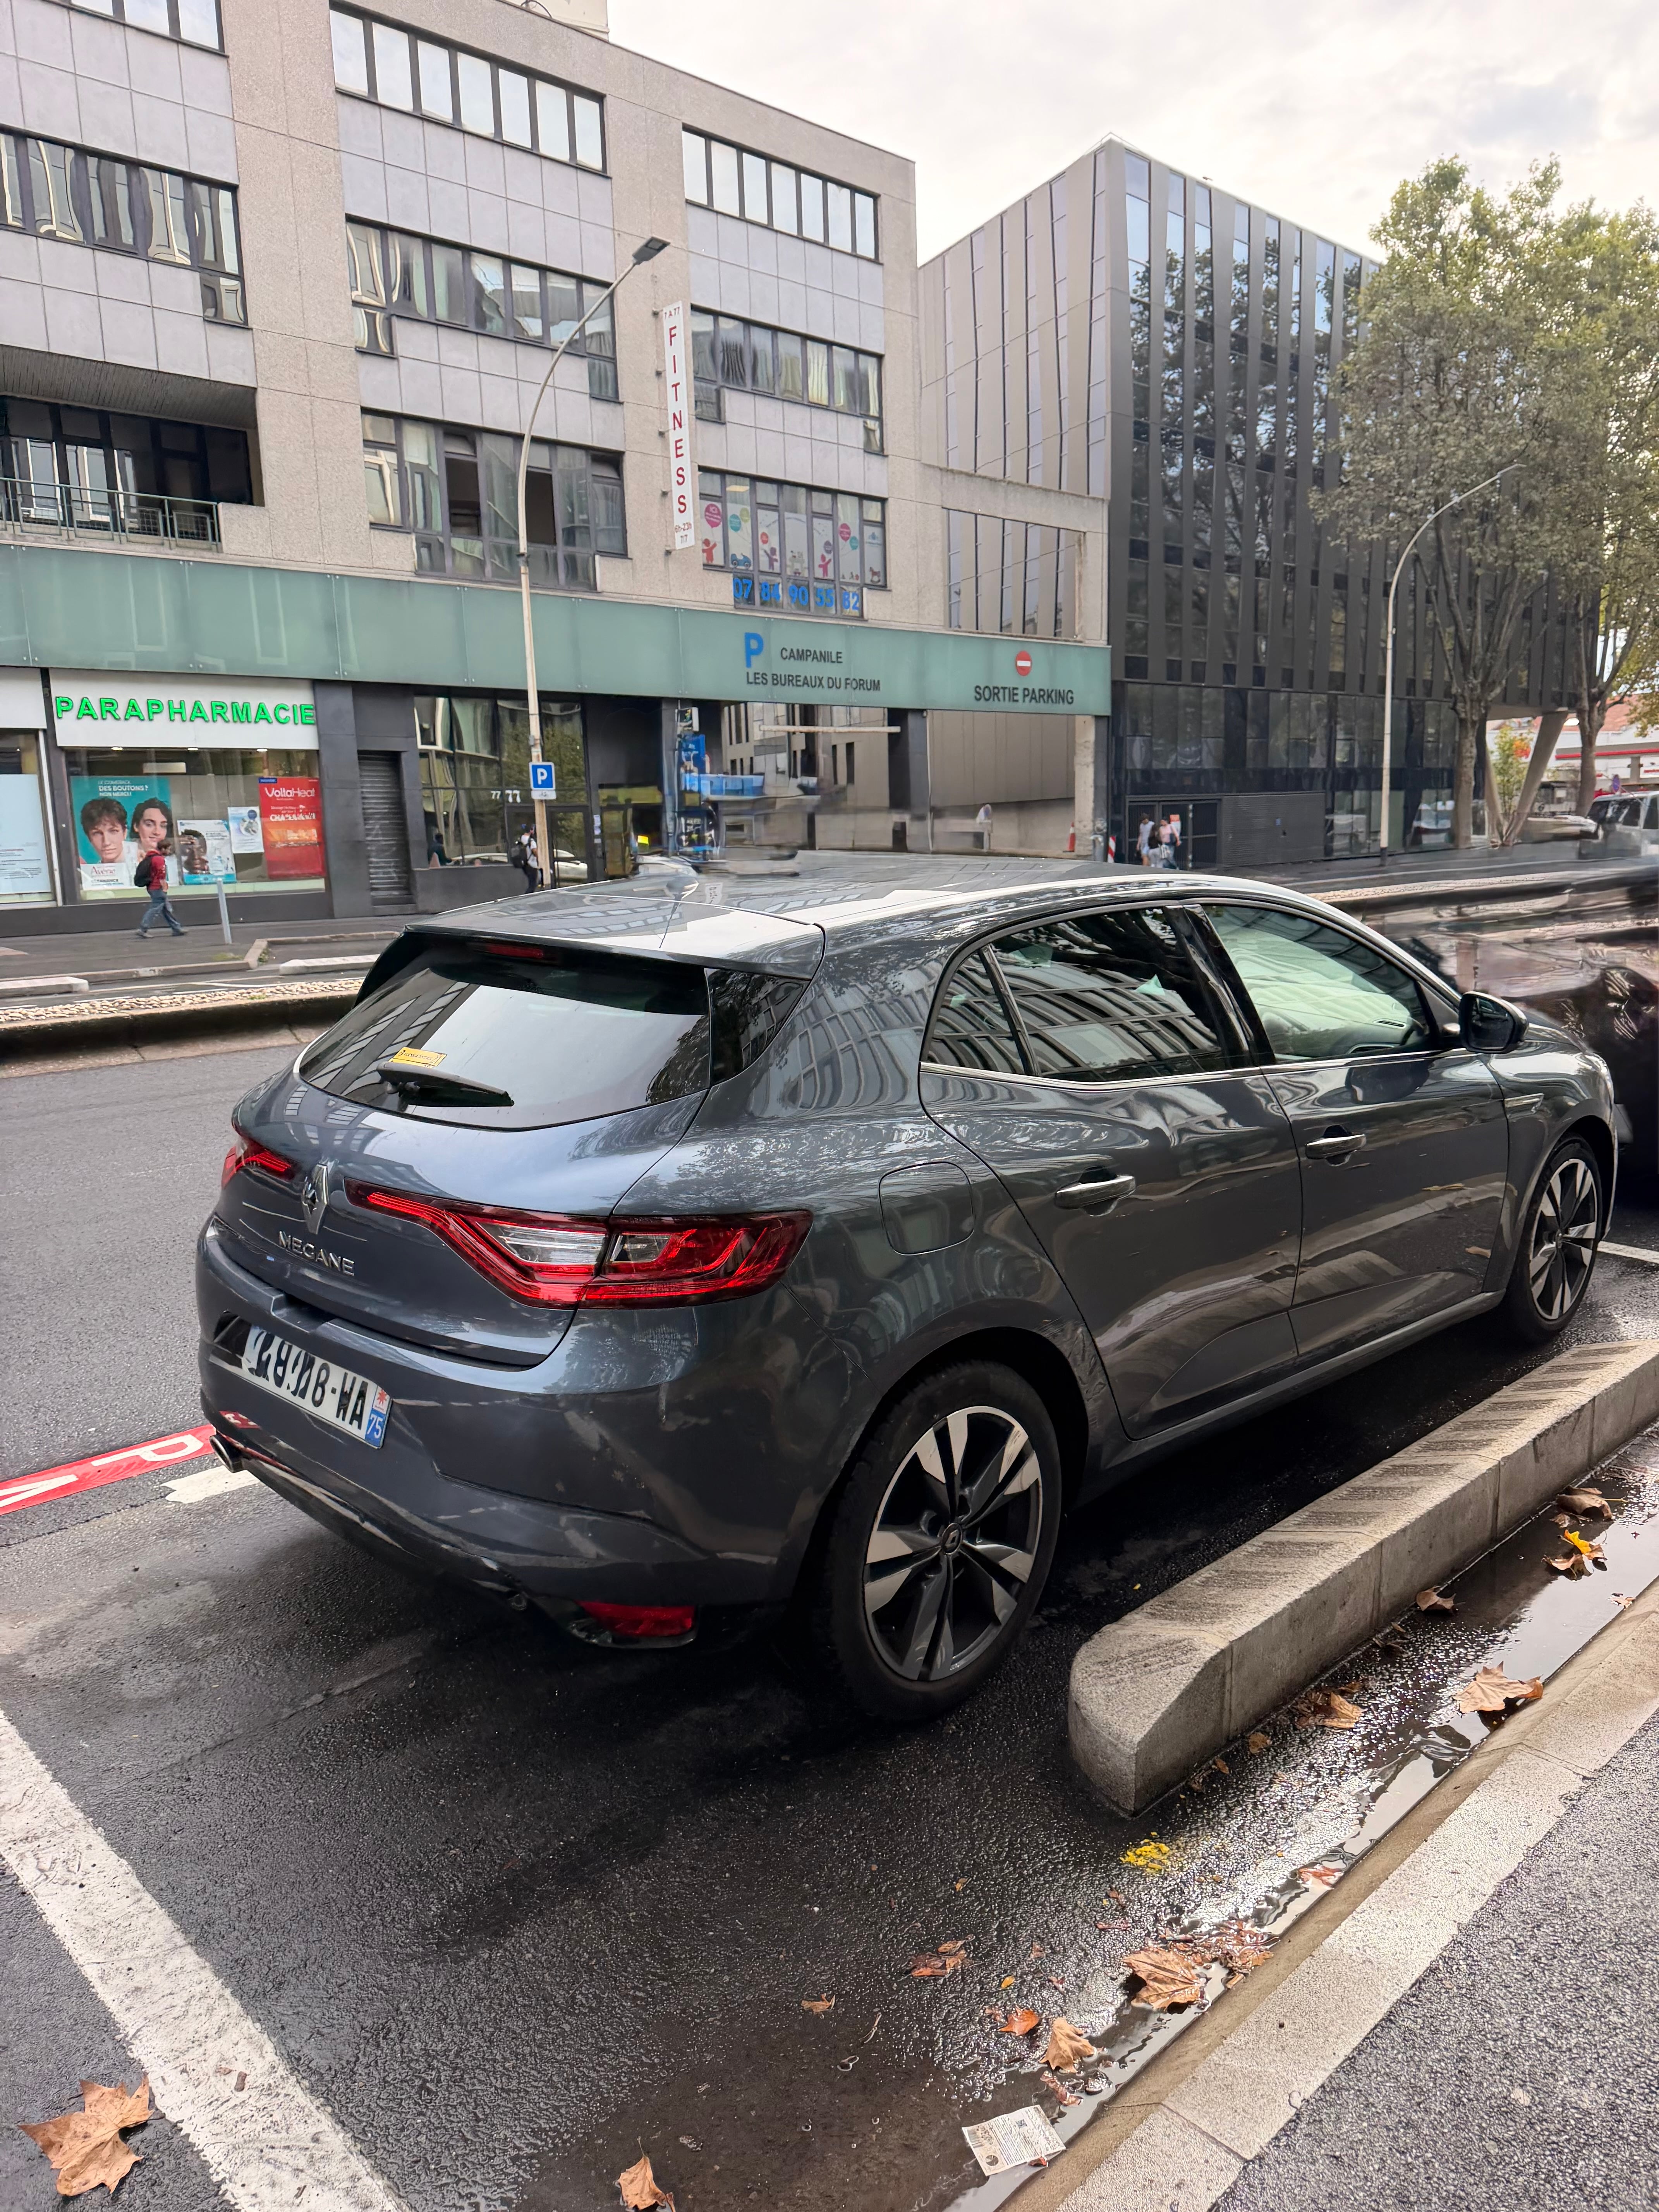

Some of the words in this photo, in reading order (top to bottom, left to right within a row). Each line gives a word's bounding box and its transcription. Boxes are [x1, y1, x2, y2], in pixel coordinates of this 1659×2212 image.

[669, 325, 687, 514] FITNESS
[733, 578, 752, 599] 07
[761, 582, 781, 601] 84
[788, 584, 809, 605] 90
[816, 587, 834, 607] 55
[842, 591, 859, 610] 82
[744, 632, 764, 668] P
[780, 647, 843, 663] CAMPANILE
[746, 672, 768, 685] LES
[771, 673, 824, 689] BUREAUX
[827, 677, 841, 689] DU
[845, 678, 881, 691] FORUM
[974, 685, 1019, 702] SORTIE
[1023, 687, 1074, 704] PARKING
[55, 696, 316, 725] PARAPHARMACIE
[537, 768, 548, 785] P
[278, 1231, 355, 1276] MEGANE
[366, 1413, 383, 1439] 75
